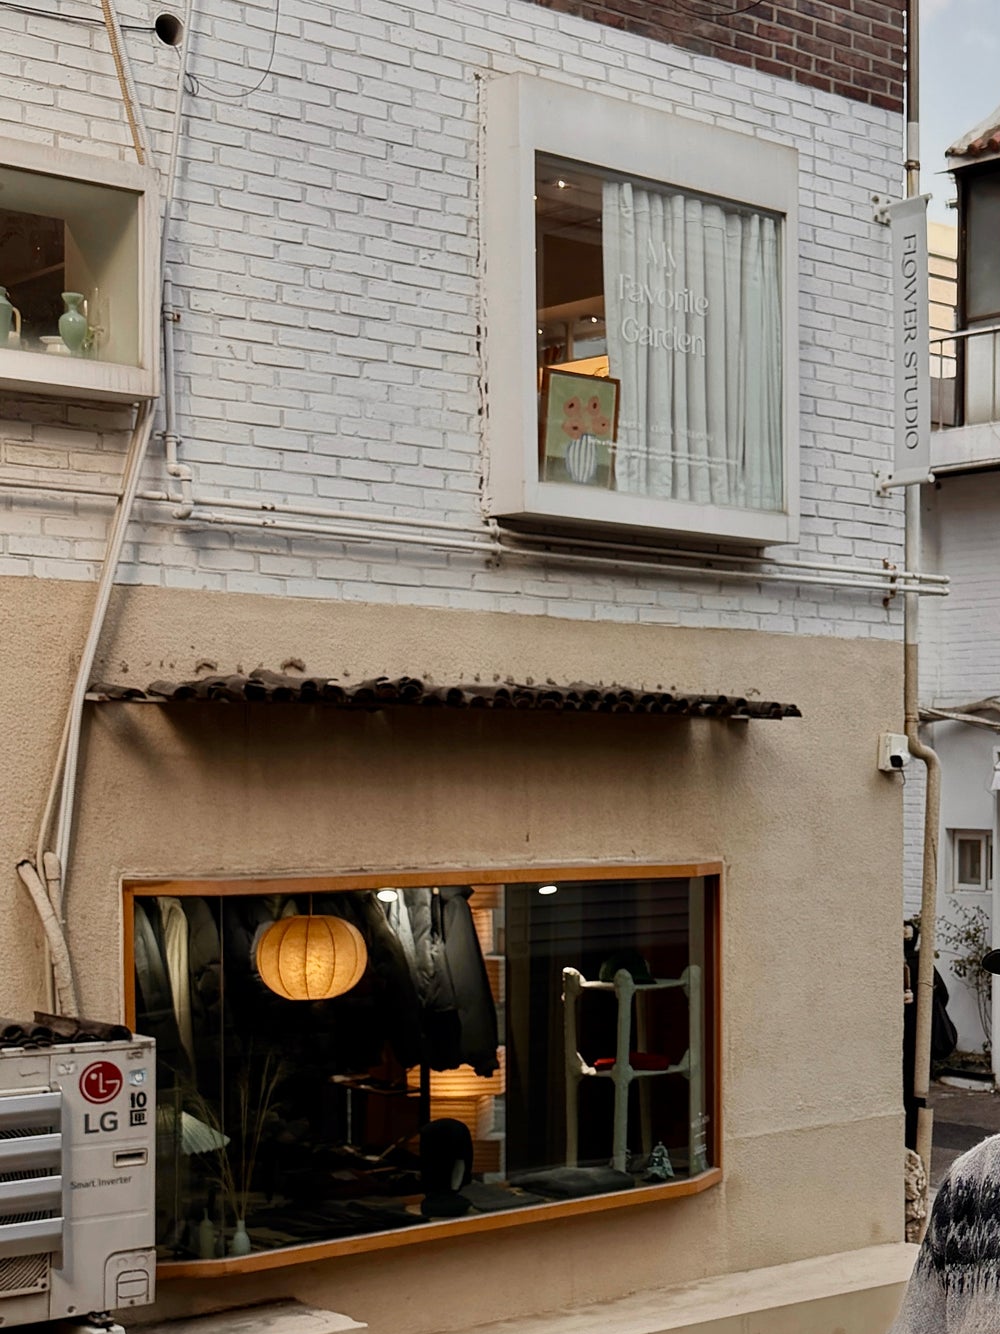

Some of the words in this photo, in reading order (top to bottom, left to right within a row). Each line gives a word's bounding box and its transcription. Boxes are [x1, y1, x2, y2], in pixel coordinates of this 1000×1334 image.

[619, 273, 709, 317] Favorite
[901, 234, 917, 344] FLOWER
[621, 316, 706, 358] Garden
[903, 351, 919, 450] STUDIO
[84, 1111, 119, 1134] LG
[70, 1180, 95, 1190] Smart
[98, 1175, 132, 1187] Inverter
